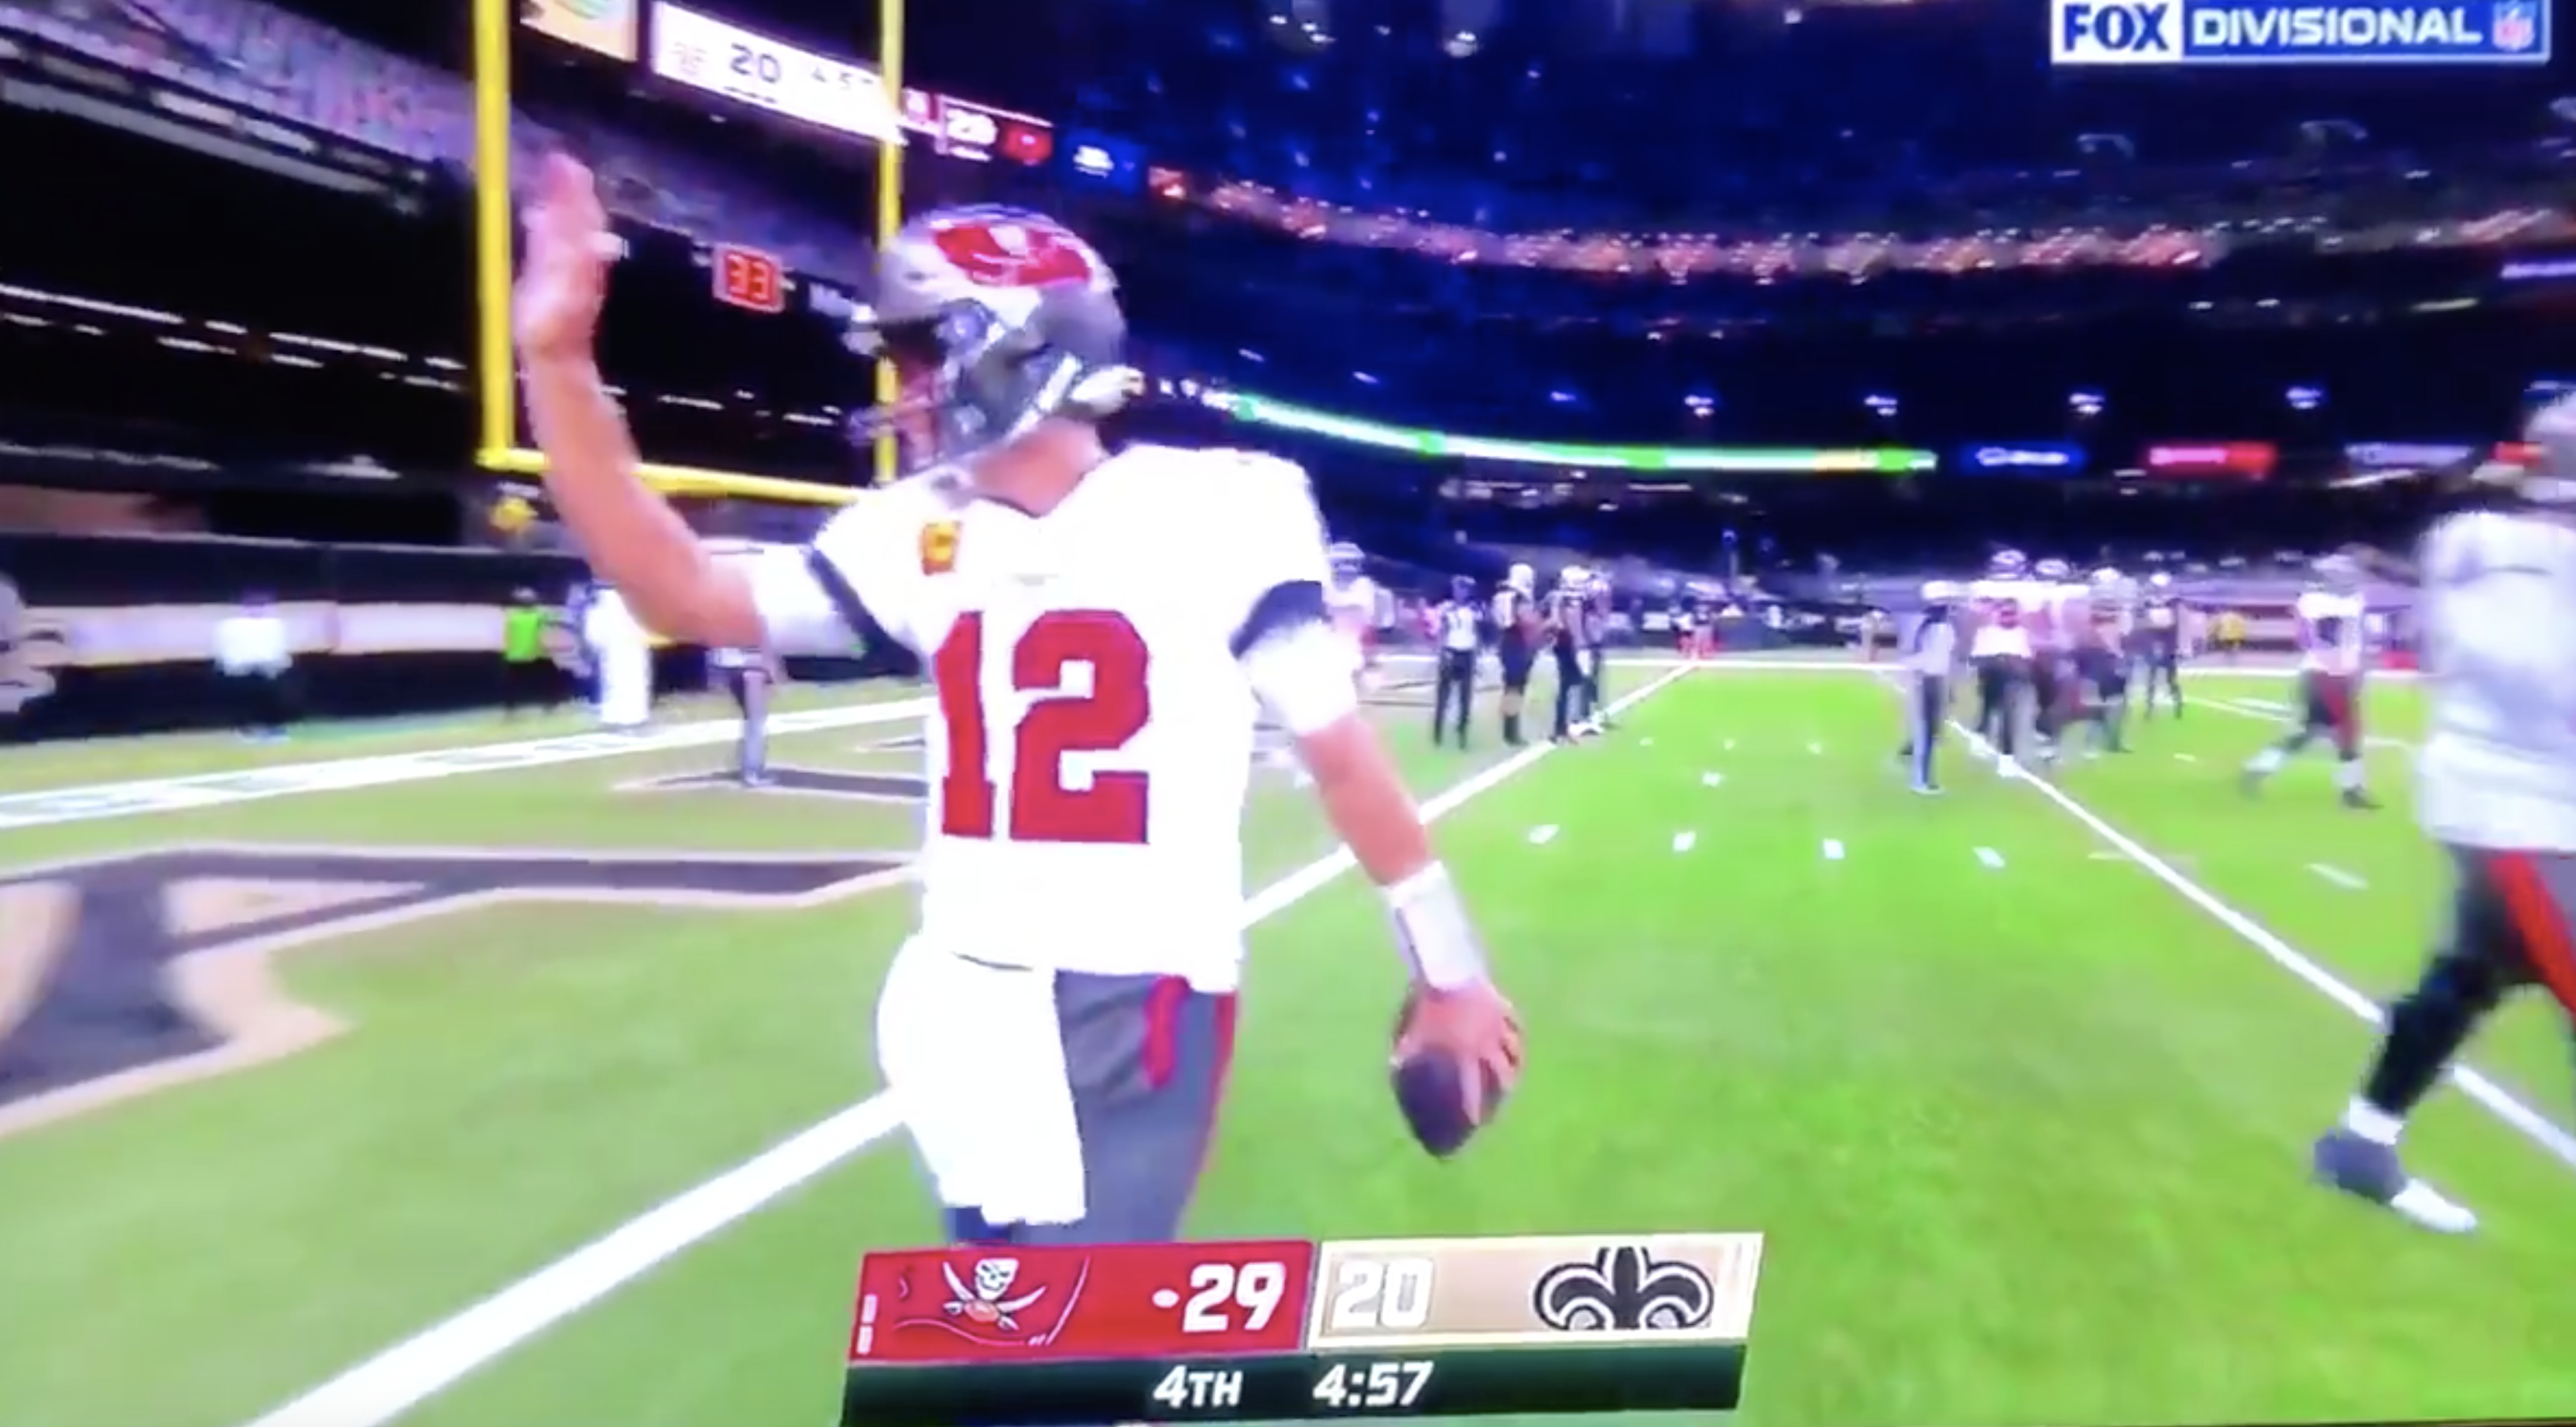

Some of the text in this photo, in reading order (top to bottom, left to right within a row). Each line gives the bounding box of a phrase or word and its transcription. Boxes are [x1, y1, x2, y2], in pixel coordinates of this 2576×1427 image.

[729, 42, 783, 84] 20
[727, 253, 769, 302] 33
[936, 608, 1150, 845] 12
